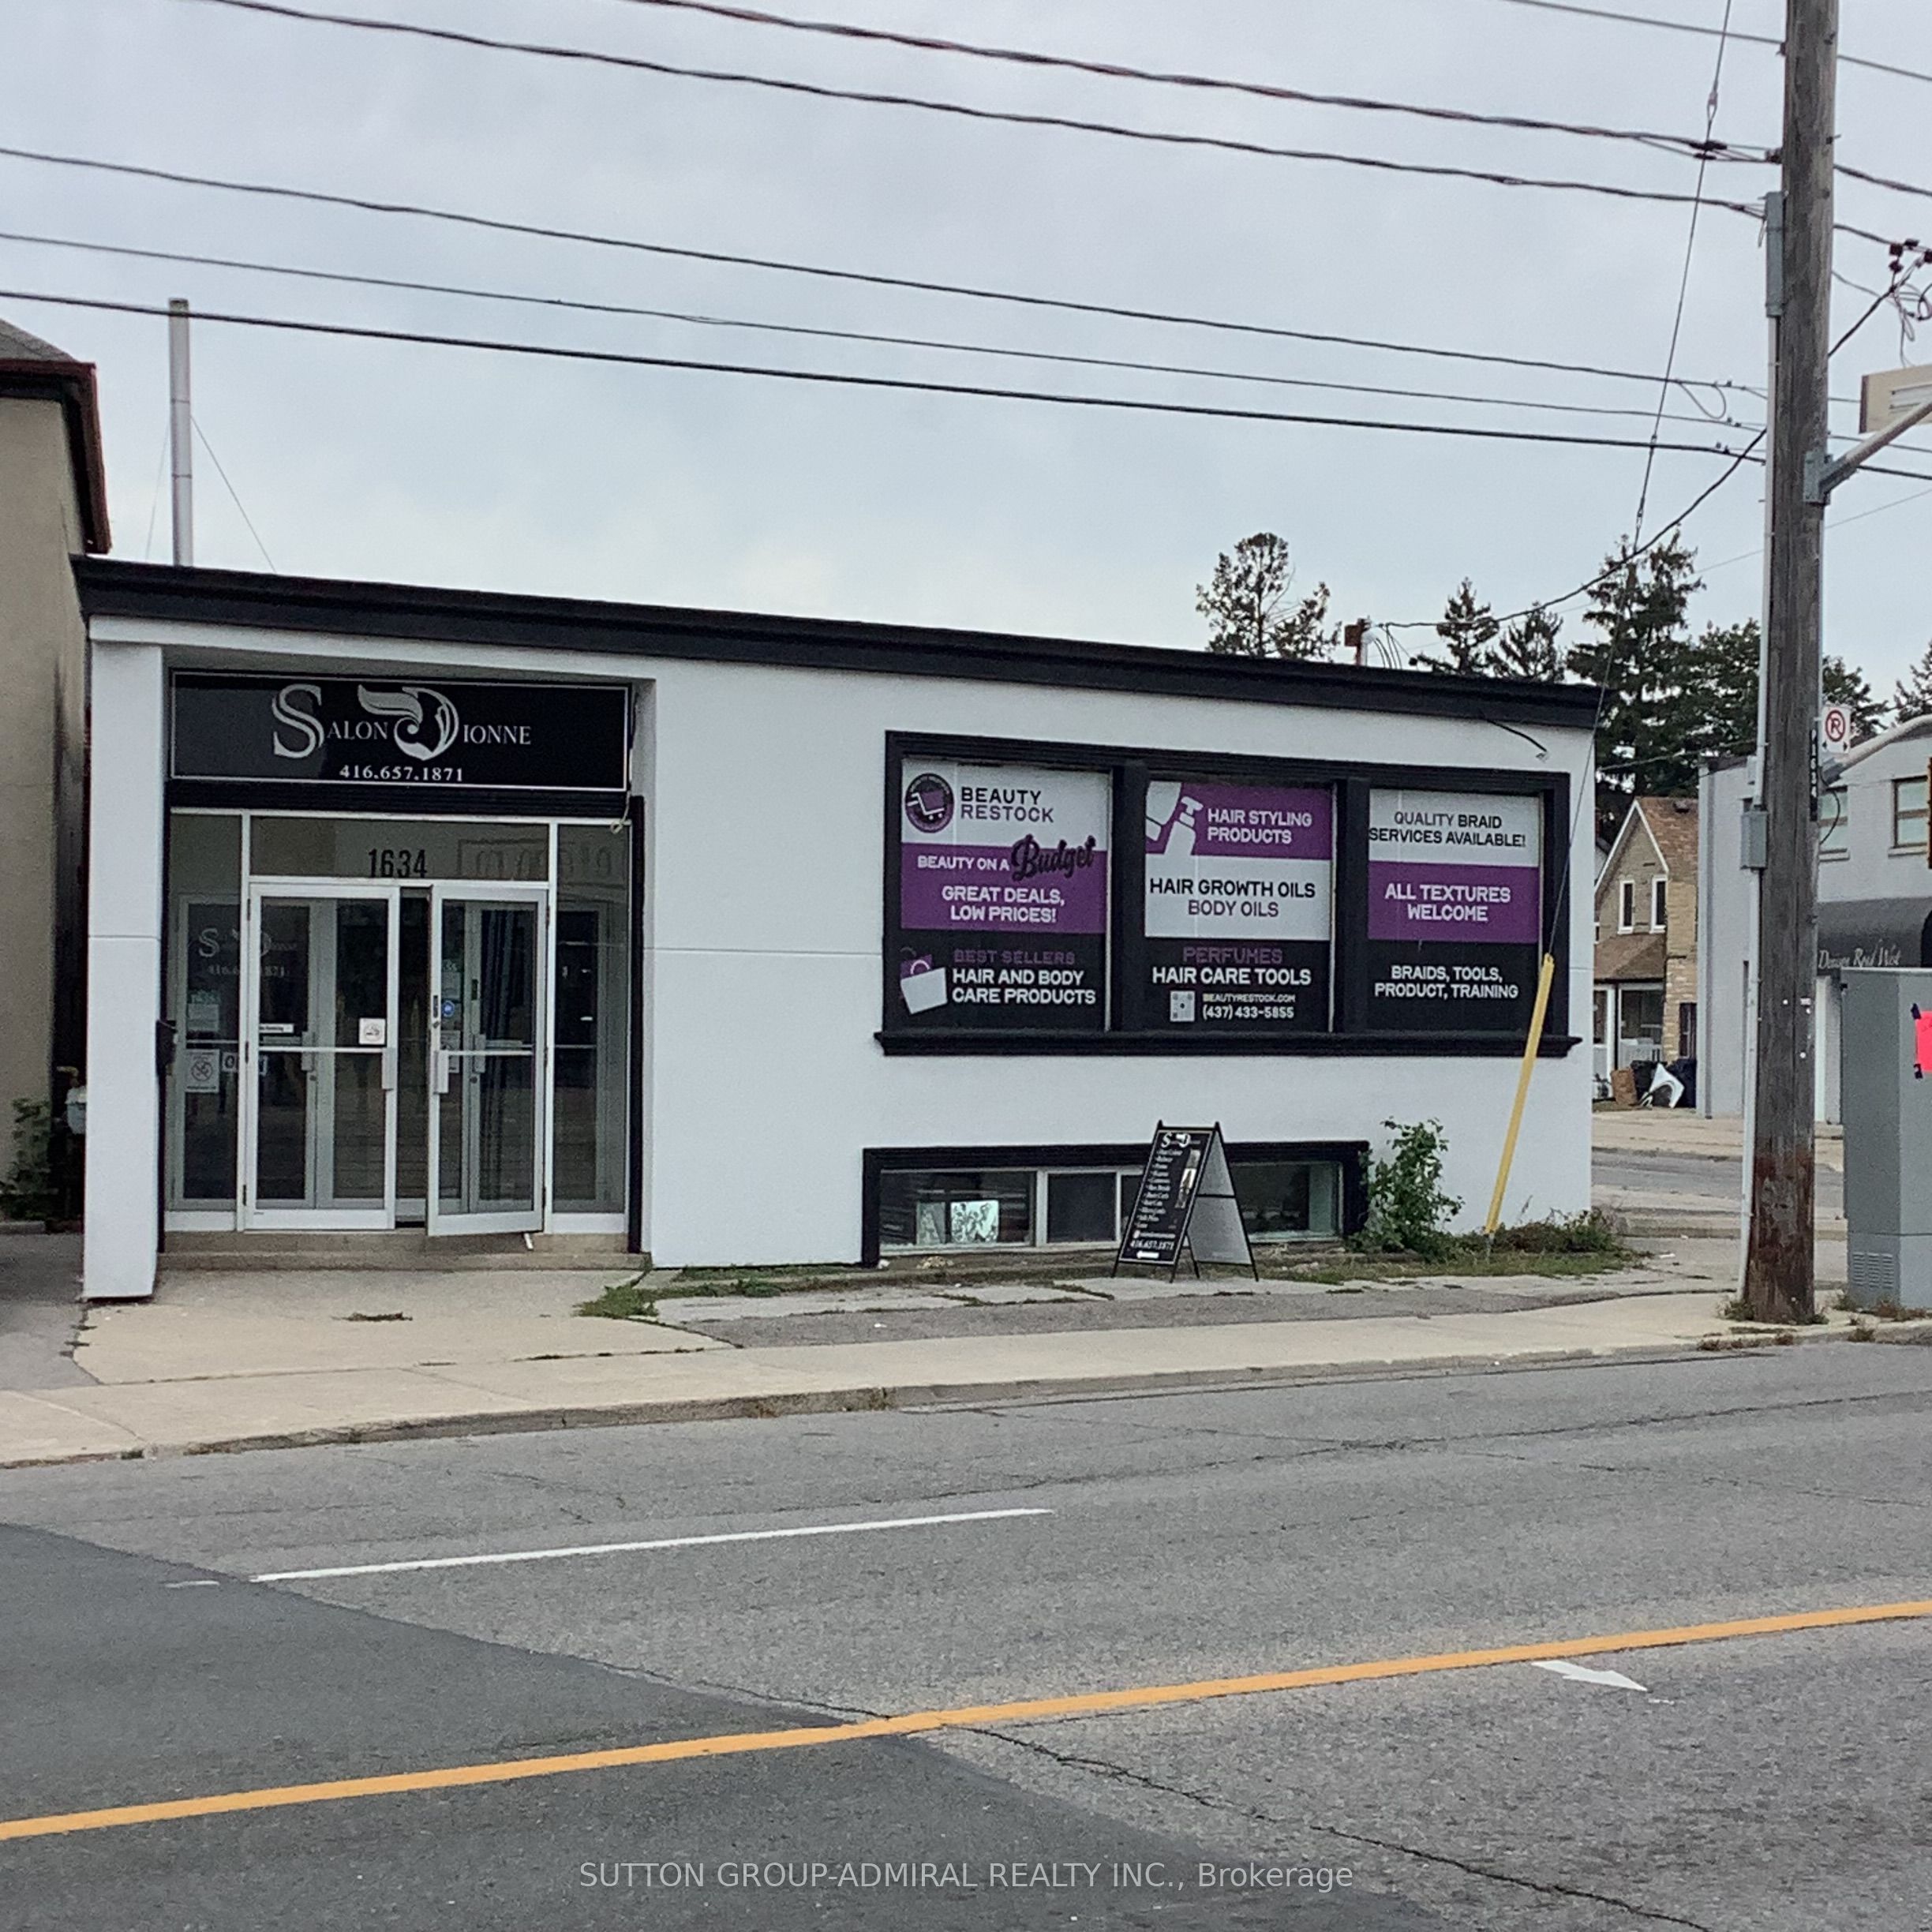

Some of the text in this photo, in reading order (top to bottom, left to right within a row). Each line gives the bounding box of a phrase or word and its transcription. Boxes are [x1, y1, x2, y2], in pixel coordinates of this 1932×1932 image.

[339, 763, 464, 782] 416.657.1871
[960, 787, 1042, 805] BEAUTY
[960, 803, 1054, 823] RESTOCK
[1207, 808, 1312, 827] HAIR STYLING
[1394, 811, 1503, 829] QUALITY BRAID
[1207, 826, 1293, 844] PRODUCTS
[1368, 828, 1526, 848] SERVICES AVAILABLE!
[367, 848, 428, 878] 1634
[917, 833, 1096, 882] BEAUTY ON A Budget
[942, 886, 1065, 907] GREAT DEALS,
[1149, 878, 1316, 899] HAIR GROWTH OILS
[1384, 883, 1511, 903] ALL TEXTURES
[950, 905, 1057, 923] LOW PRICES!
[1188, 900, 1279, 918] BODY OILS
[1407, 904, 1488, 922] WELCOME
[954, 949, 1076, 965] BEST SELLERS
[1183, 948, 1283, 964] PERFUMES
[952, 968, 1084, 986] HAIR AND BODY
[1151, 967, 1312, 986] HAIR CARE TOOLS
[1391, 965, 1503, 983] BRAIDS, TOOLS,
[952, 987, 1096, 1005] CARE PRODUCTS
[1374, 983, 1519, 1000] PRODUCT, TRAINING
[1202, 1005, 1294, 1020] (437) 433-5855
